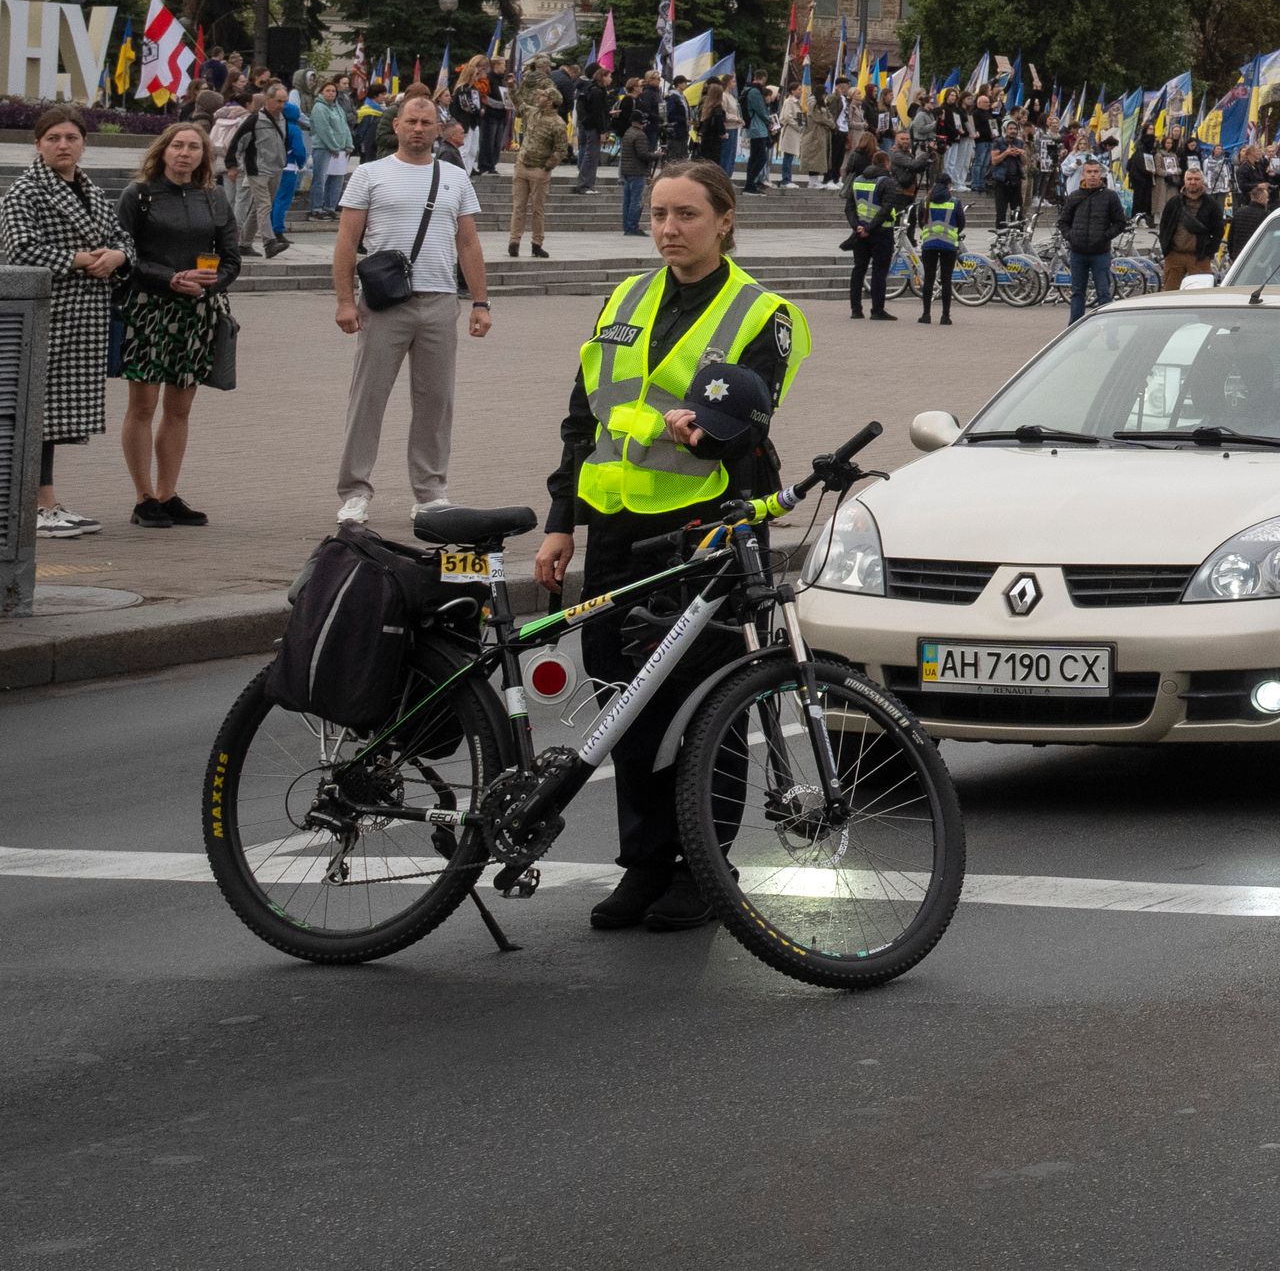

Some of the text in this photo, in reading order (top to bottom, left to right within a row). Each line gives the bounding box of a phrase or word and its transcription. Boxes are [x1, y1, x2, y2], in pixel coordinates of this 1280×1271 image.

[925, 668, 937, 676] UA
[940, 649, 1101, 683] AH 7190 CX
[582, 615, 690, 755] ПАТРУЛЬНА ПОЛІЦІЯ
[993, 687, 1034, 695] RENAULT
[212, 752, 229, 838] MAXXIS
